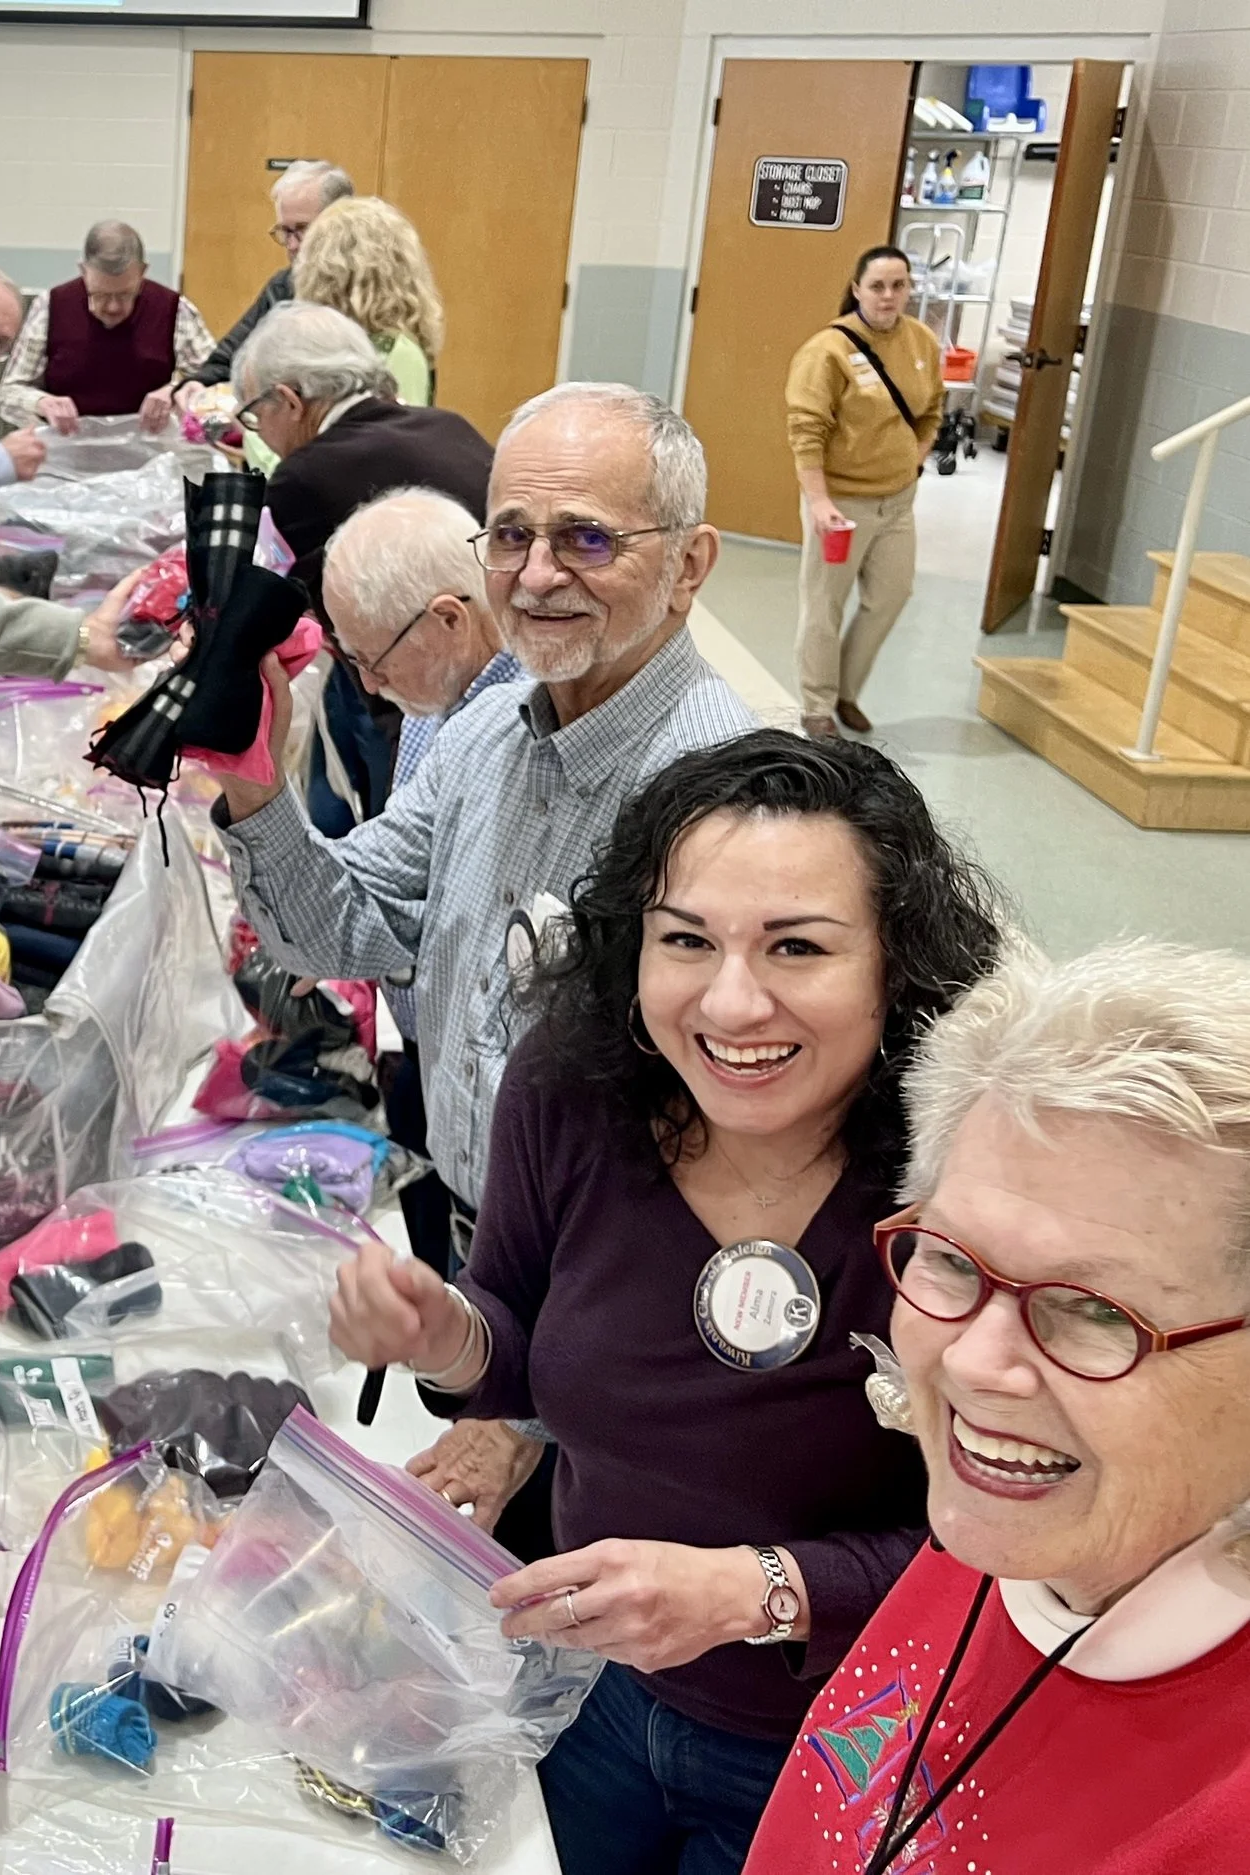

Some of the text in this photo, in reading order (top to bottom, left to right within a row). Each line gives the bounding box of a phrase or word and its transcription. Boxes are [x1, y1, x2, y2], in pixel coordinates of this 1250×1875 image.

[759, 163, 843, 183] STORAGE CLOSET
[749, 1288, 764, 1320] Alma
